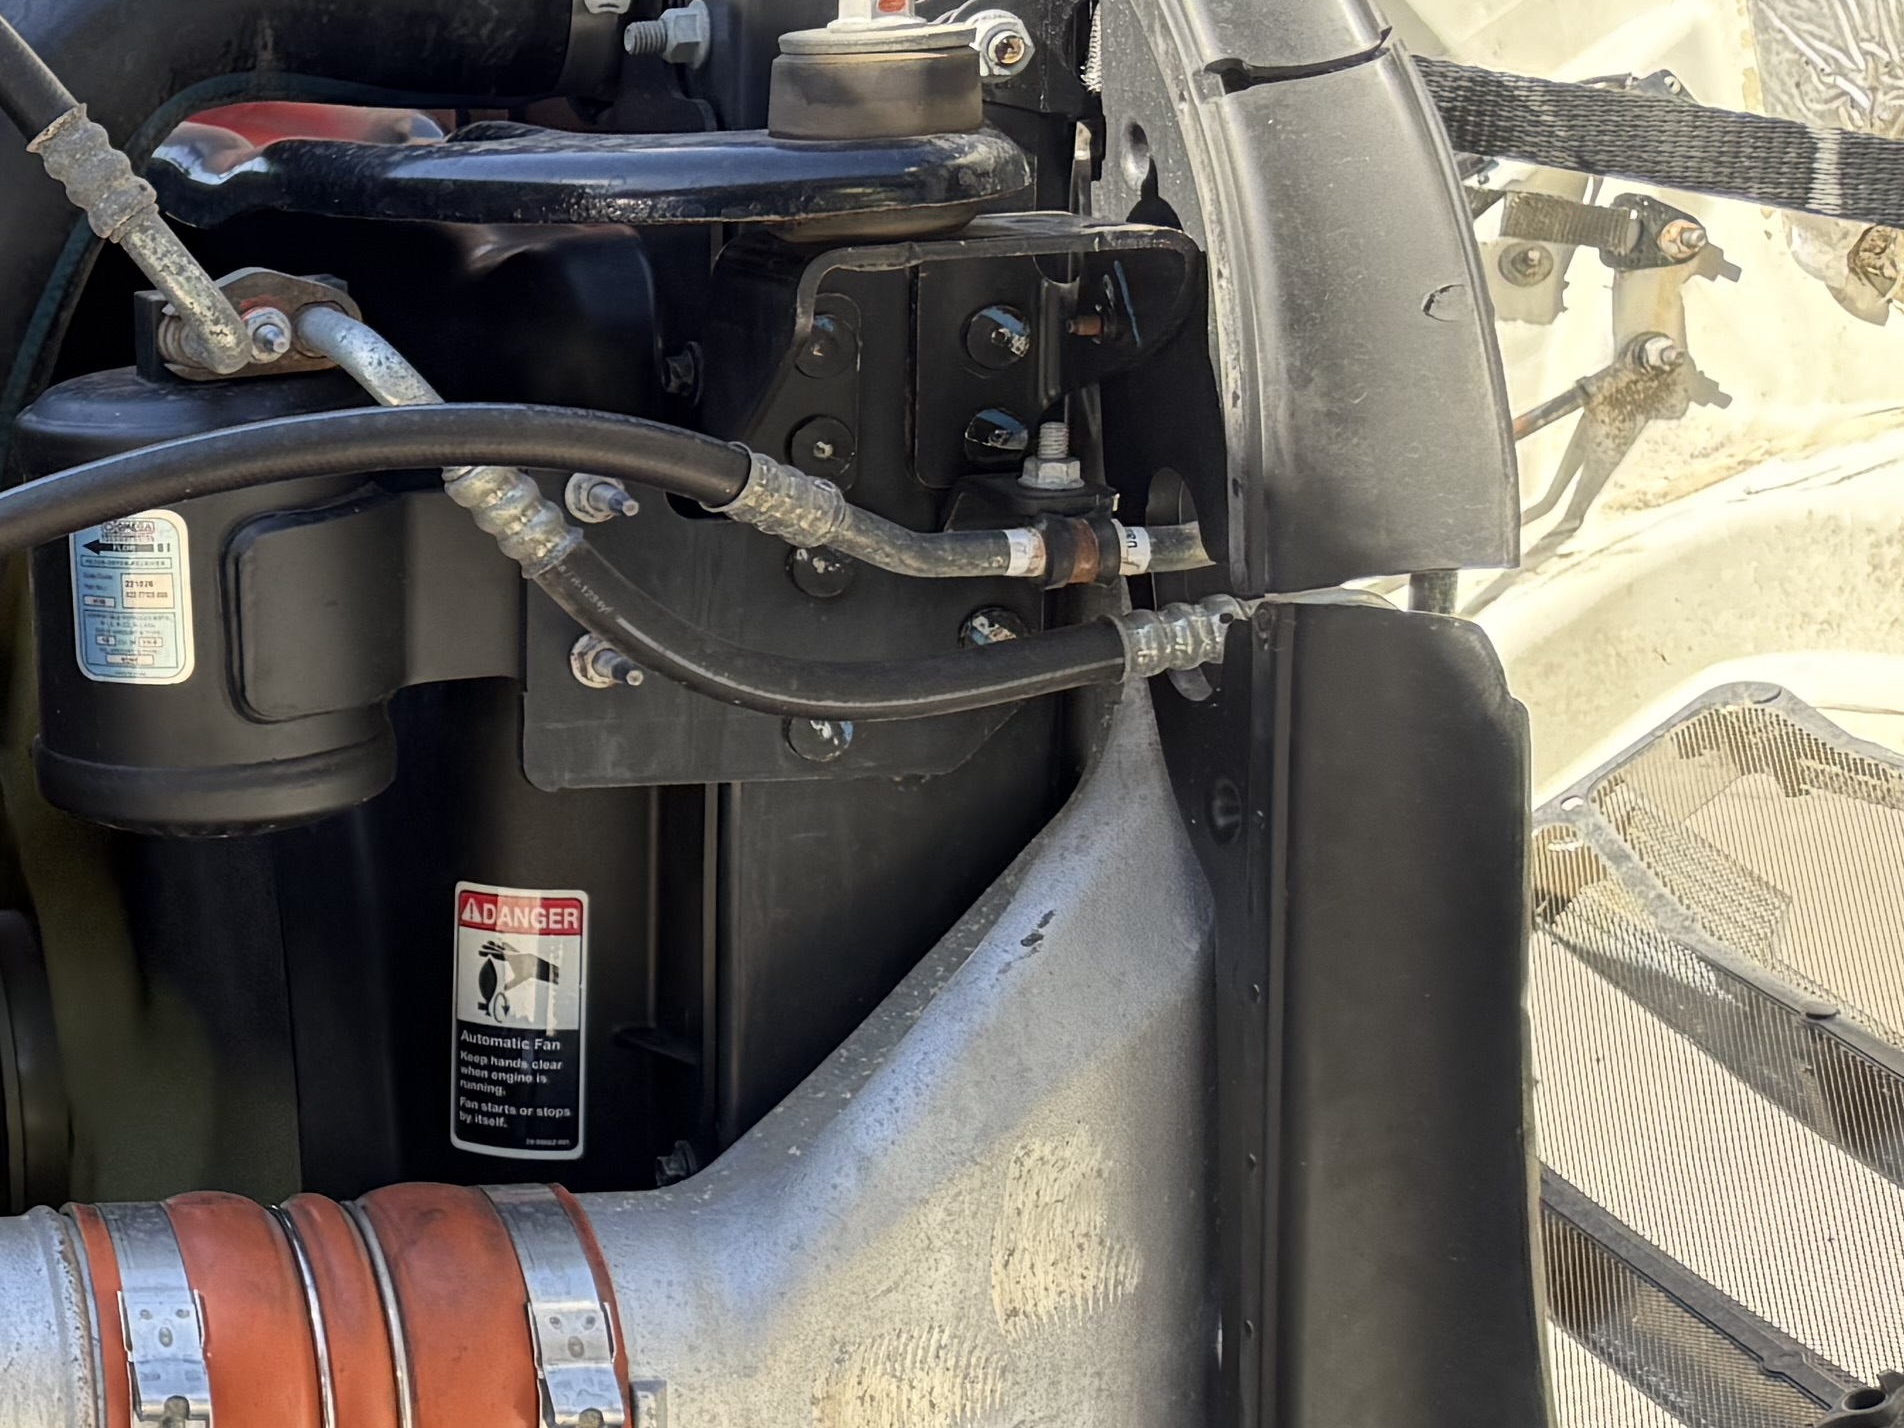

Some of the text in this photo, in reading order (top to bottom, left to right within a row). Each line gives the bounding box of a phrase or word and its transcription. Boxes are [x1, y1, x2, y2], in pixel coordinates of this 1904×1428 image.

[482, 903, 579, 930] DANGER
[460, 1029, 561, 1051] Automatic Fan
[460, 1050, 563, 1070] Keep hands clear
[460, 1066, 548, 1084] when engine is
[460, 1096, 571, 1119] Fan starts or stops
[460, 1110, 508, 1128] by itself.
